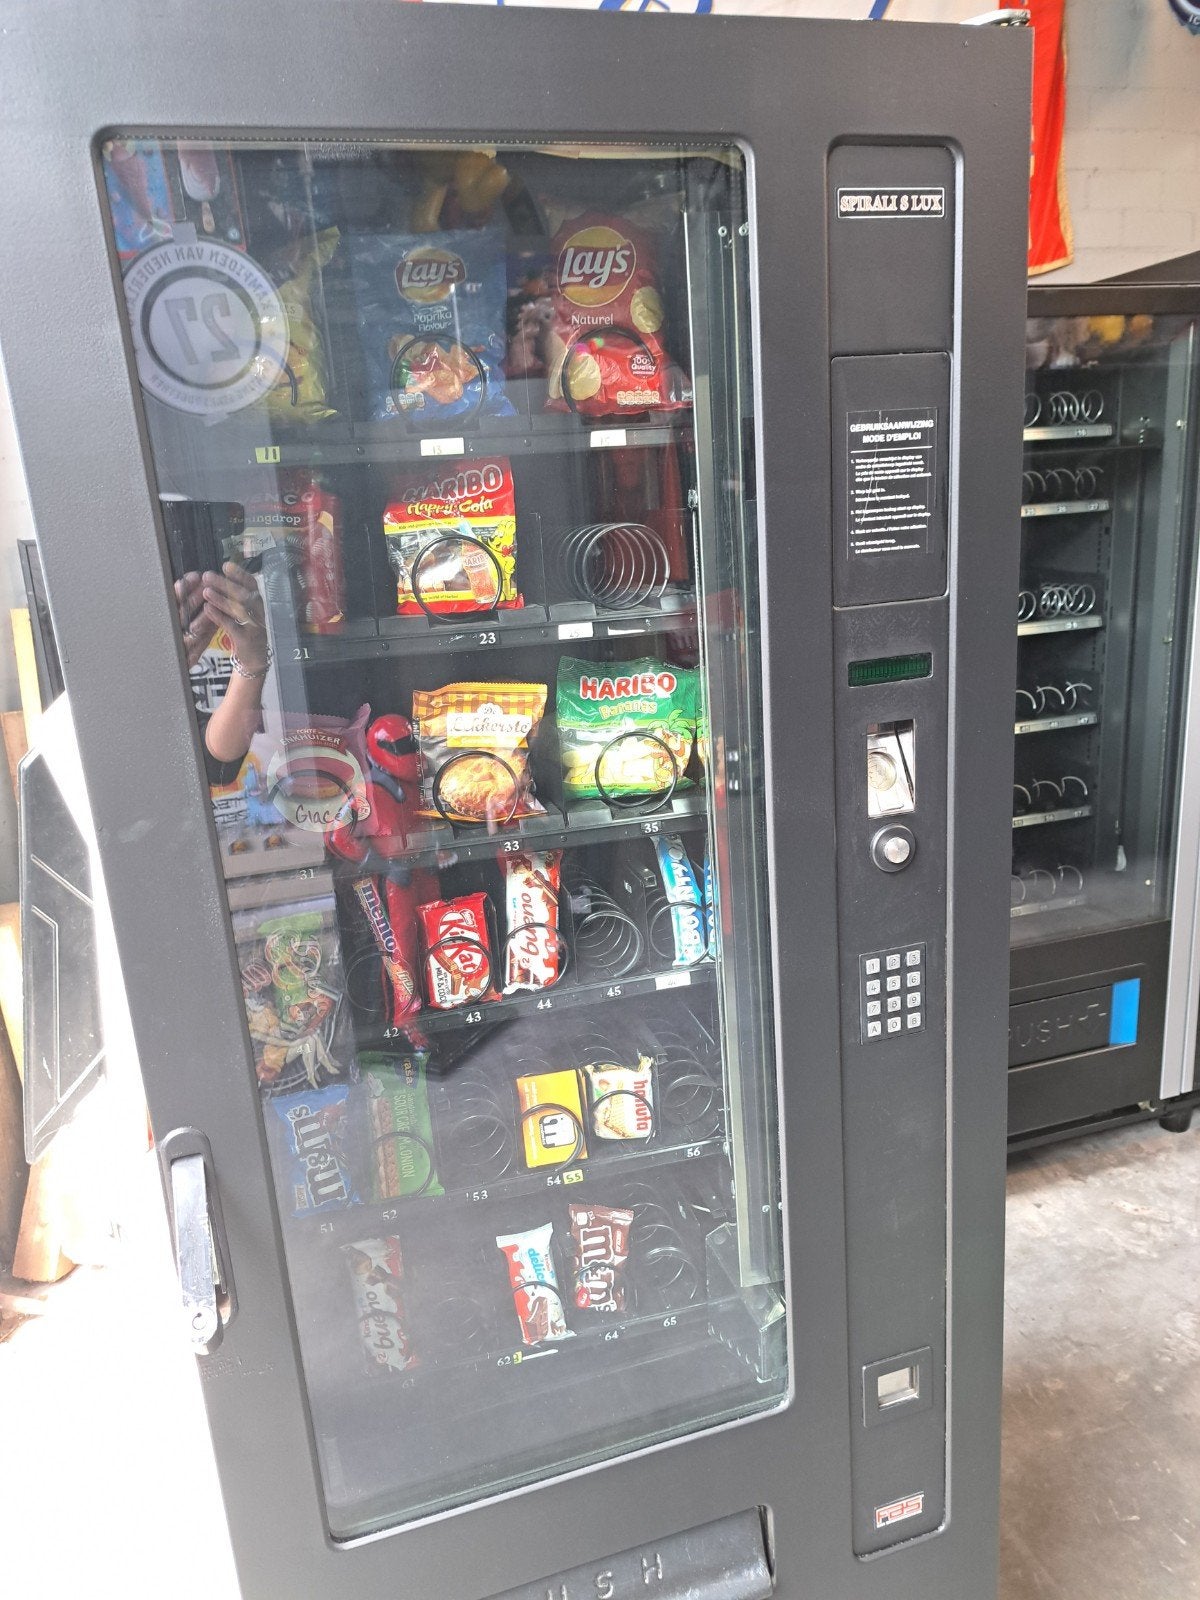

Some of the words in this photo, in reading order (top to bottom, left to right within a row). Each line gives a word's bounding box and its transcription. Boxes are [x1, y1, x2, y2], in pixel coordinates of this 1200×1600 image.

[840, 194, 898, 212] SPIRALI
[900, 194, 909, 212] S
[911, 194, 943, 212] LUX
[561, 245, 631, 289] Lay's
[401, 261, 461, 289] Lay's
[571, 313, 614, 326] Naturel
[862, 432, 886, 444] MODE
[886, 431, 921, 443] D'EMPLOI
[402, 464, 504, 502] HARIBO
[479, 632, 497, 645] 23
[293, 648, 310, 660] 21
[580, 672, 677, 700] HARIBO
[280, 733, 341, 747] ENKHUIZER
[644, 822, 659, 834] 35
[503, 840, 520, 852] 33
[300, 868, 315, 880] 31
[606, 985, 622, 998] 45
[536, 998, 553, 1011] 44
[465, 1011, 482, 1024] 43
[383, 1026, 399, 1039] 42
[393, 1095, 408, 1116] SOUR
[396, 1117, 410, 1145] CREM
[686, 1147, 701, 1158] 56
[400, 1151, 416, 1178] ONION
[546, 1176, 562, 1187] 54
[565, 1173, 581, 1183] 55
[473, 1190, 489, 1202] 53
[382, 1209, 398, 1221] 52
[320, 1222, 334, 1234] 51
[663, 1316, 677, 1328] 65
[604, 1330, 619, 1341] 64
[497, 1355, 512, 1367] 62
